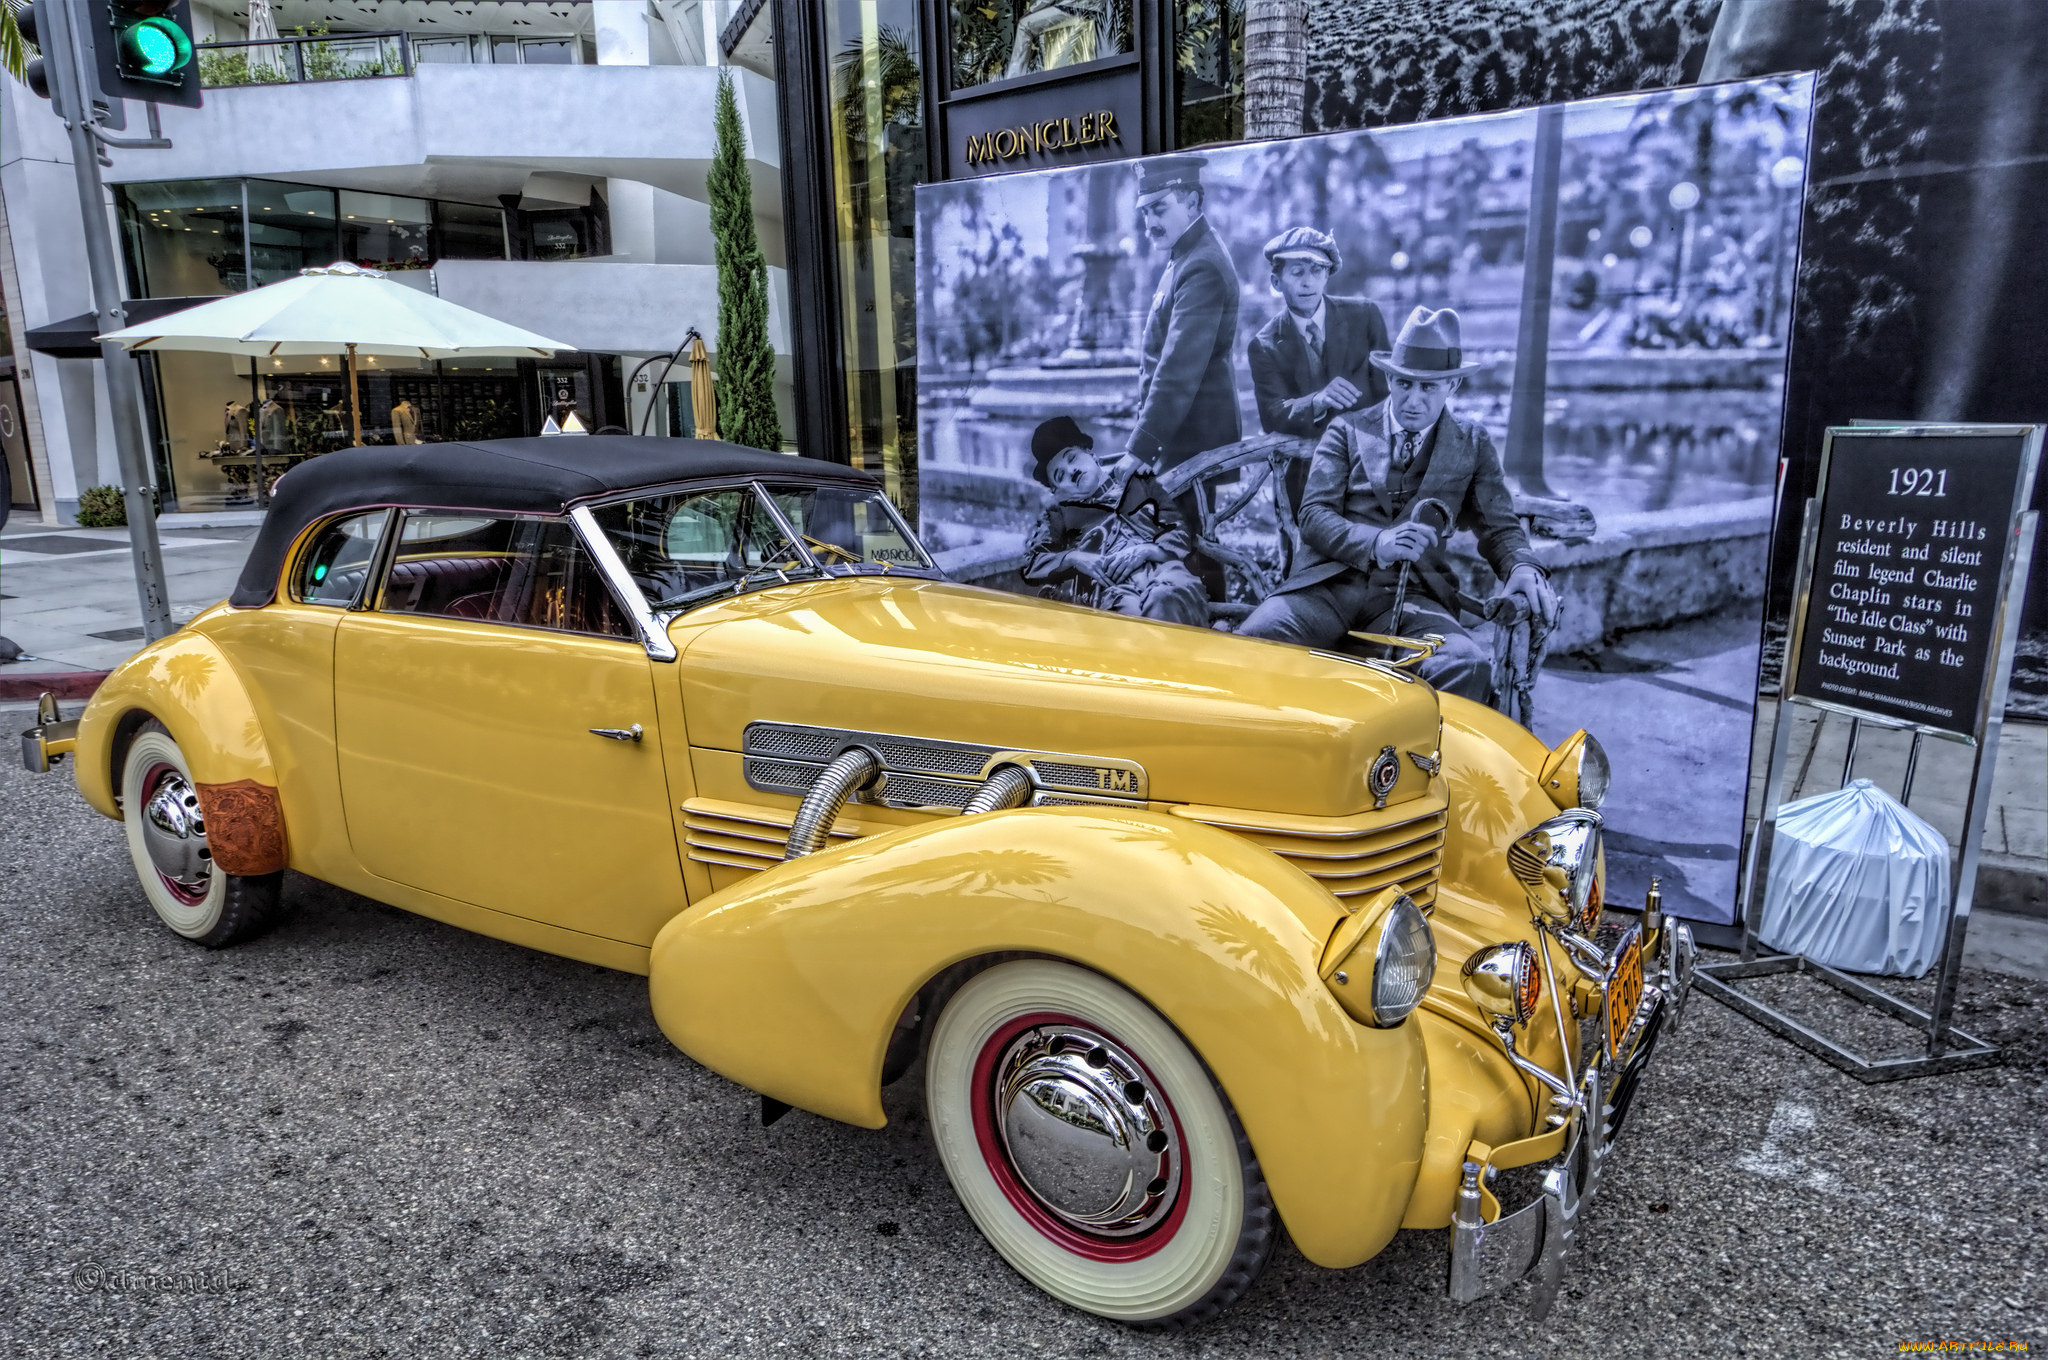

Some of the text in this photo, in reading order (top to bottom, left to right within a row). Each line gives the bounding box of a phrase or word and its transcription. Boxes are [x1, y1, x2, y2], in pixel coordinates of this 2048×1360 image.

[965, 110, 1118, 164] MONCLER
[554, 242, 566, 250] 332
[1887, 467, 1947, 497] 1921
[1840, 513, 1986, 540] Beverly Hills
[1836, 538, 1982, 566] resident and silent
[1833, 559, 1978, 591] film legend Charlie
[1830, 582, 1972, 617] Chaplin stars in
[1860, 610, 1887, 628] Idle
[1935, 624, 1968, 642] with
[1822, 628, 1964, 667] Sunset Park as the
[1818, 649, 1900, 680] background.
[1821, 681, 1839, 692] PHOTO
[1095, 768, 1131, 792] TM
